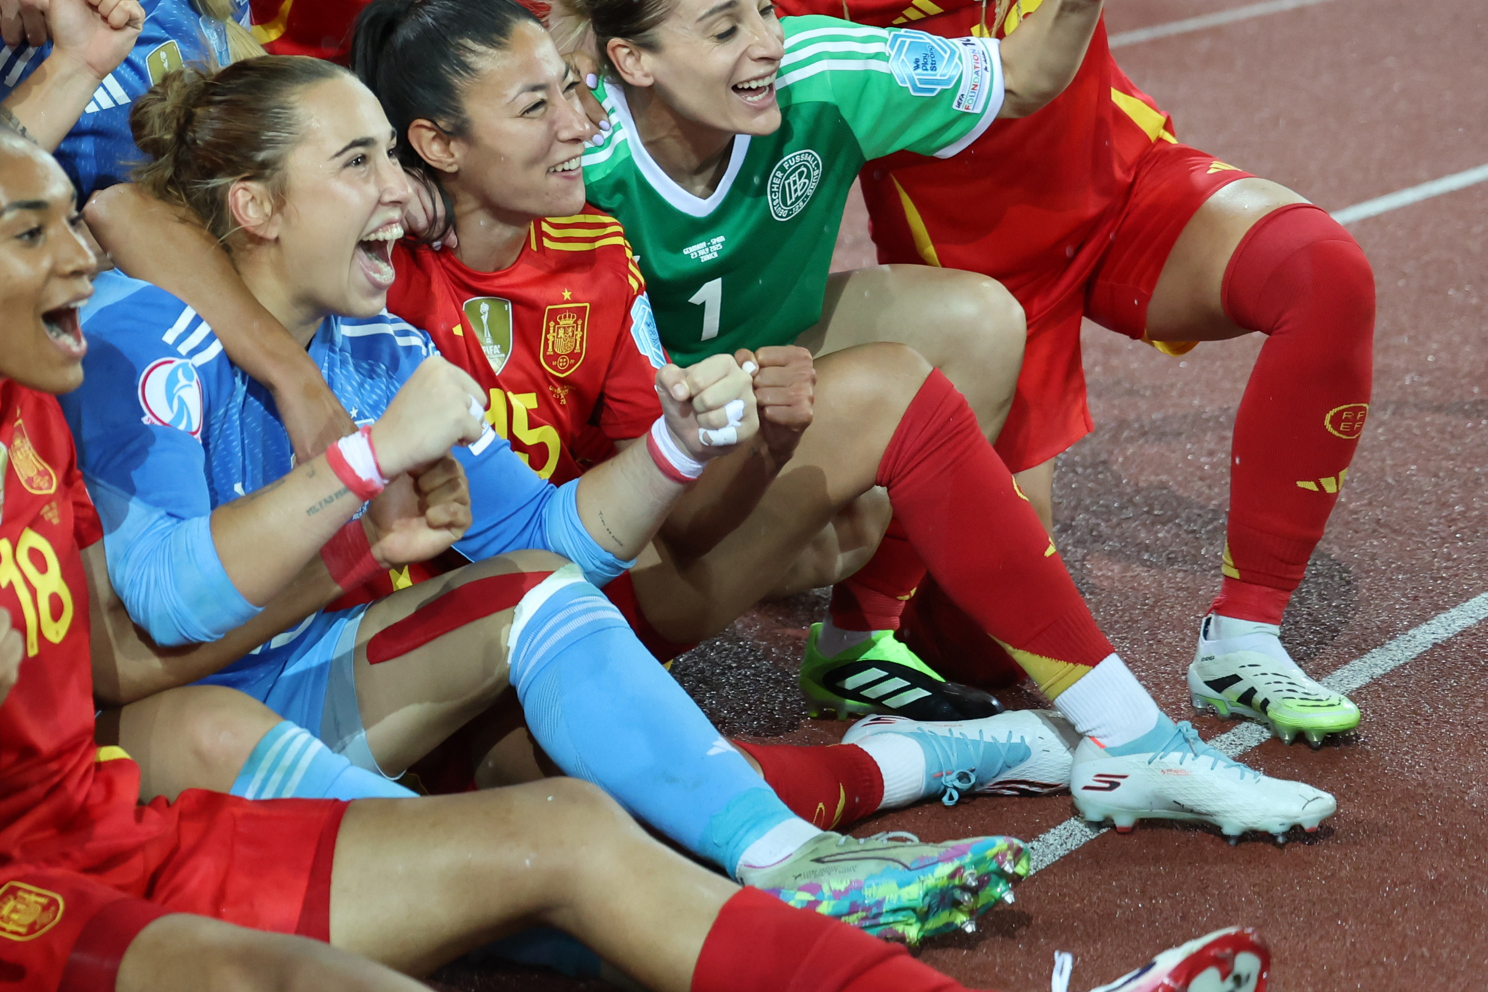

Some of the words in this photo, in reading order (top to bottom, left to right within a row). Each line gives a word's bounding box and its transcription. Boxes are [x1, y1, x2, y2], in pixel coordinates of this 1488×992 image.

[913, 58, 920, 71] We
[964, 49, 981, 110] FOUNDATION
[955, 93, 965, 109] UEFA
[772, 171, 788, 217] DEUTSCHER
[683, 241, 707, 255] GERMANY
[710, 235, 726, 245] SPAIN
[698, 247, 710, 257] JULY
[709, 243, 723, 253] 2025
[687, 277, 722, 341] 1
[484, 388, 561, 480] 15
